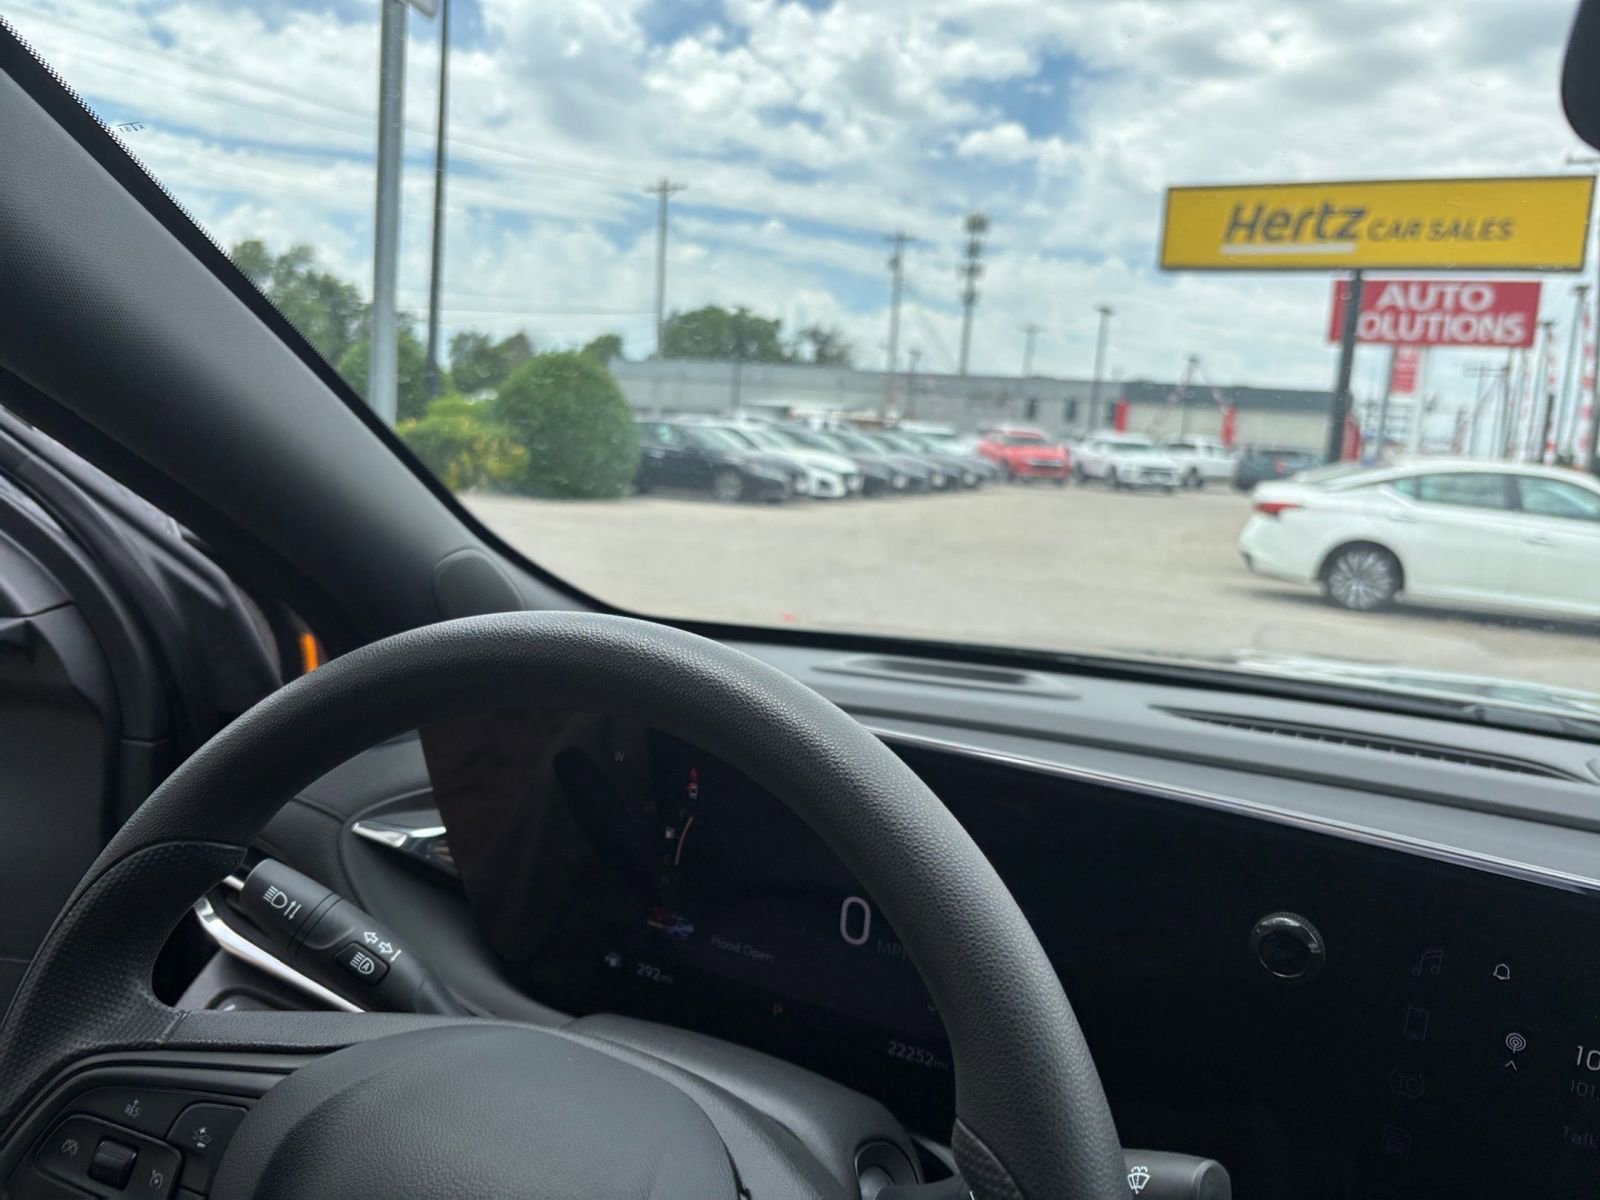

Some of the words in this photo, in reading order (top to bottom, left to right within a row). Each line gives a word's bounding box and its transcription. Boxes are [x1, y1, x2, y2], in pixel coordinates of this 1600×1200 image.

[1223, 201, 1366, 243] Hertz
[1367, 218, 1421, 241] CAR
[1426, 217, 1514, 241] SALES
[1376, 283, 1494, 313] AUTO
[1355, 311, 1525, 344] OLUTIONS
[840, 896, 871, 946] 0
[743, 944, 774, 963] Open
[772, 1003, 783, 1016] P
